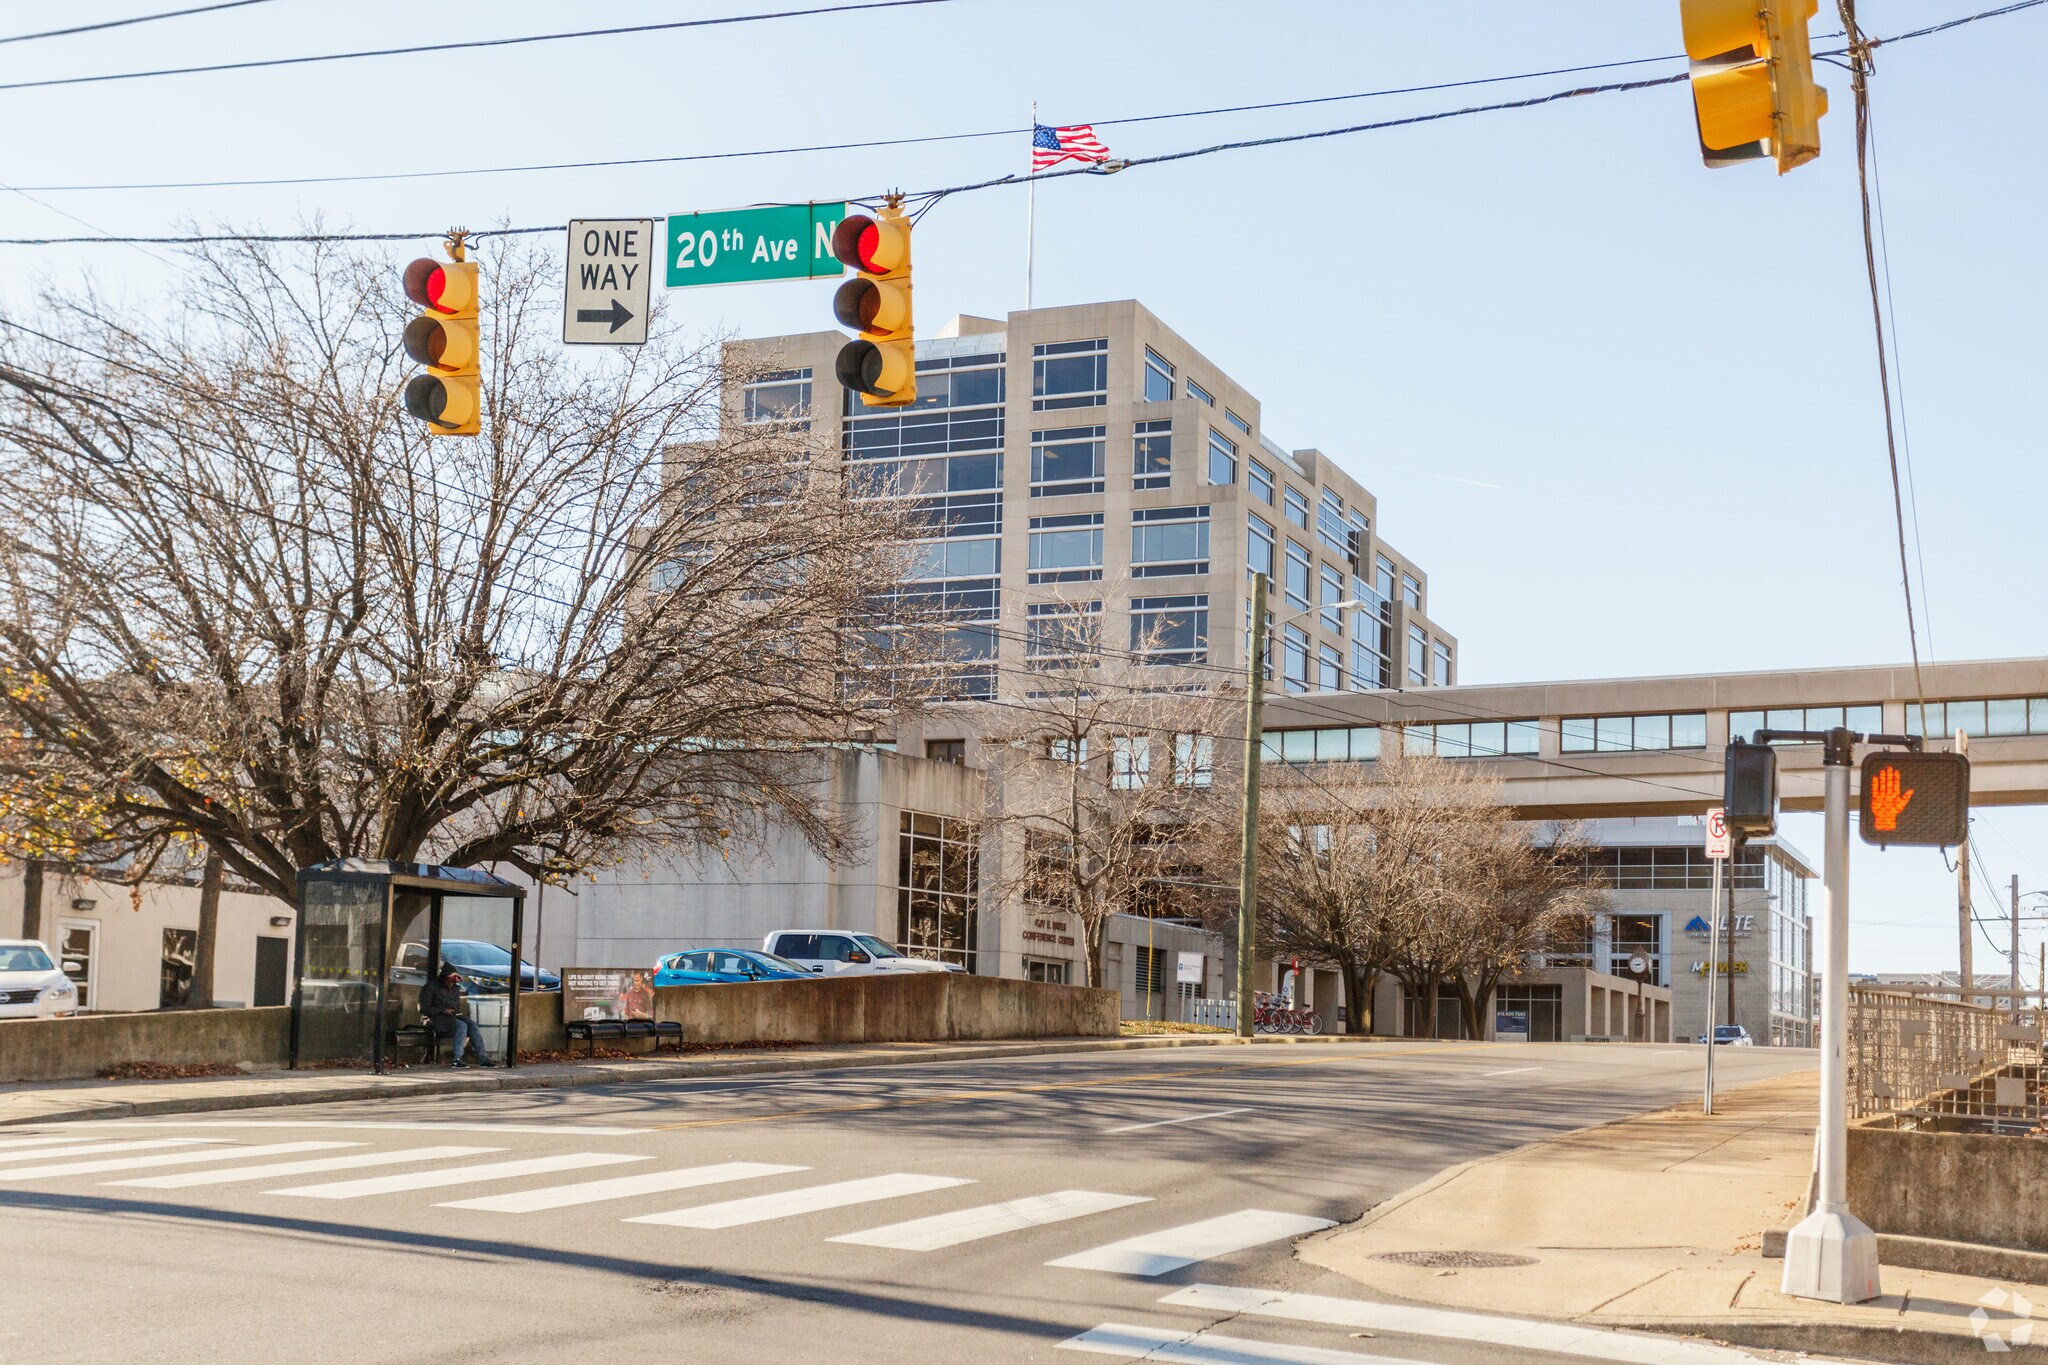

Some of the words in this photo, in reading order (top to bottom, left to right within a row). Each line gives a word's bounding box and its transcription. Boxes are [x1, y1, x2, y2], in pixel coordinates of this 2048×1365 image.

[583, 229, 639, 257] ONE
[751, 235, 799, 264] Ave
[814, 220, 836, 259] N
[580, 263, 639, 291] WAY
[1022, 930, 1057, 944] CONFERENCE
[1691, 961, 1749, 977] MPWER
